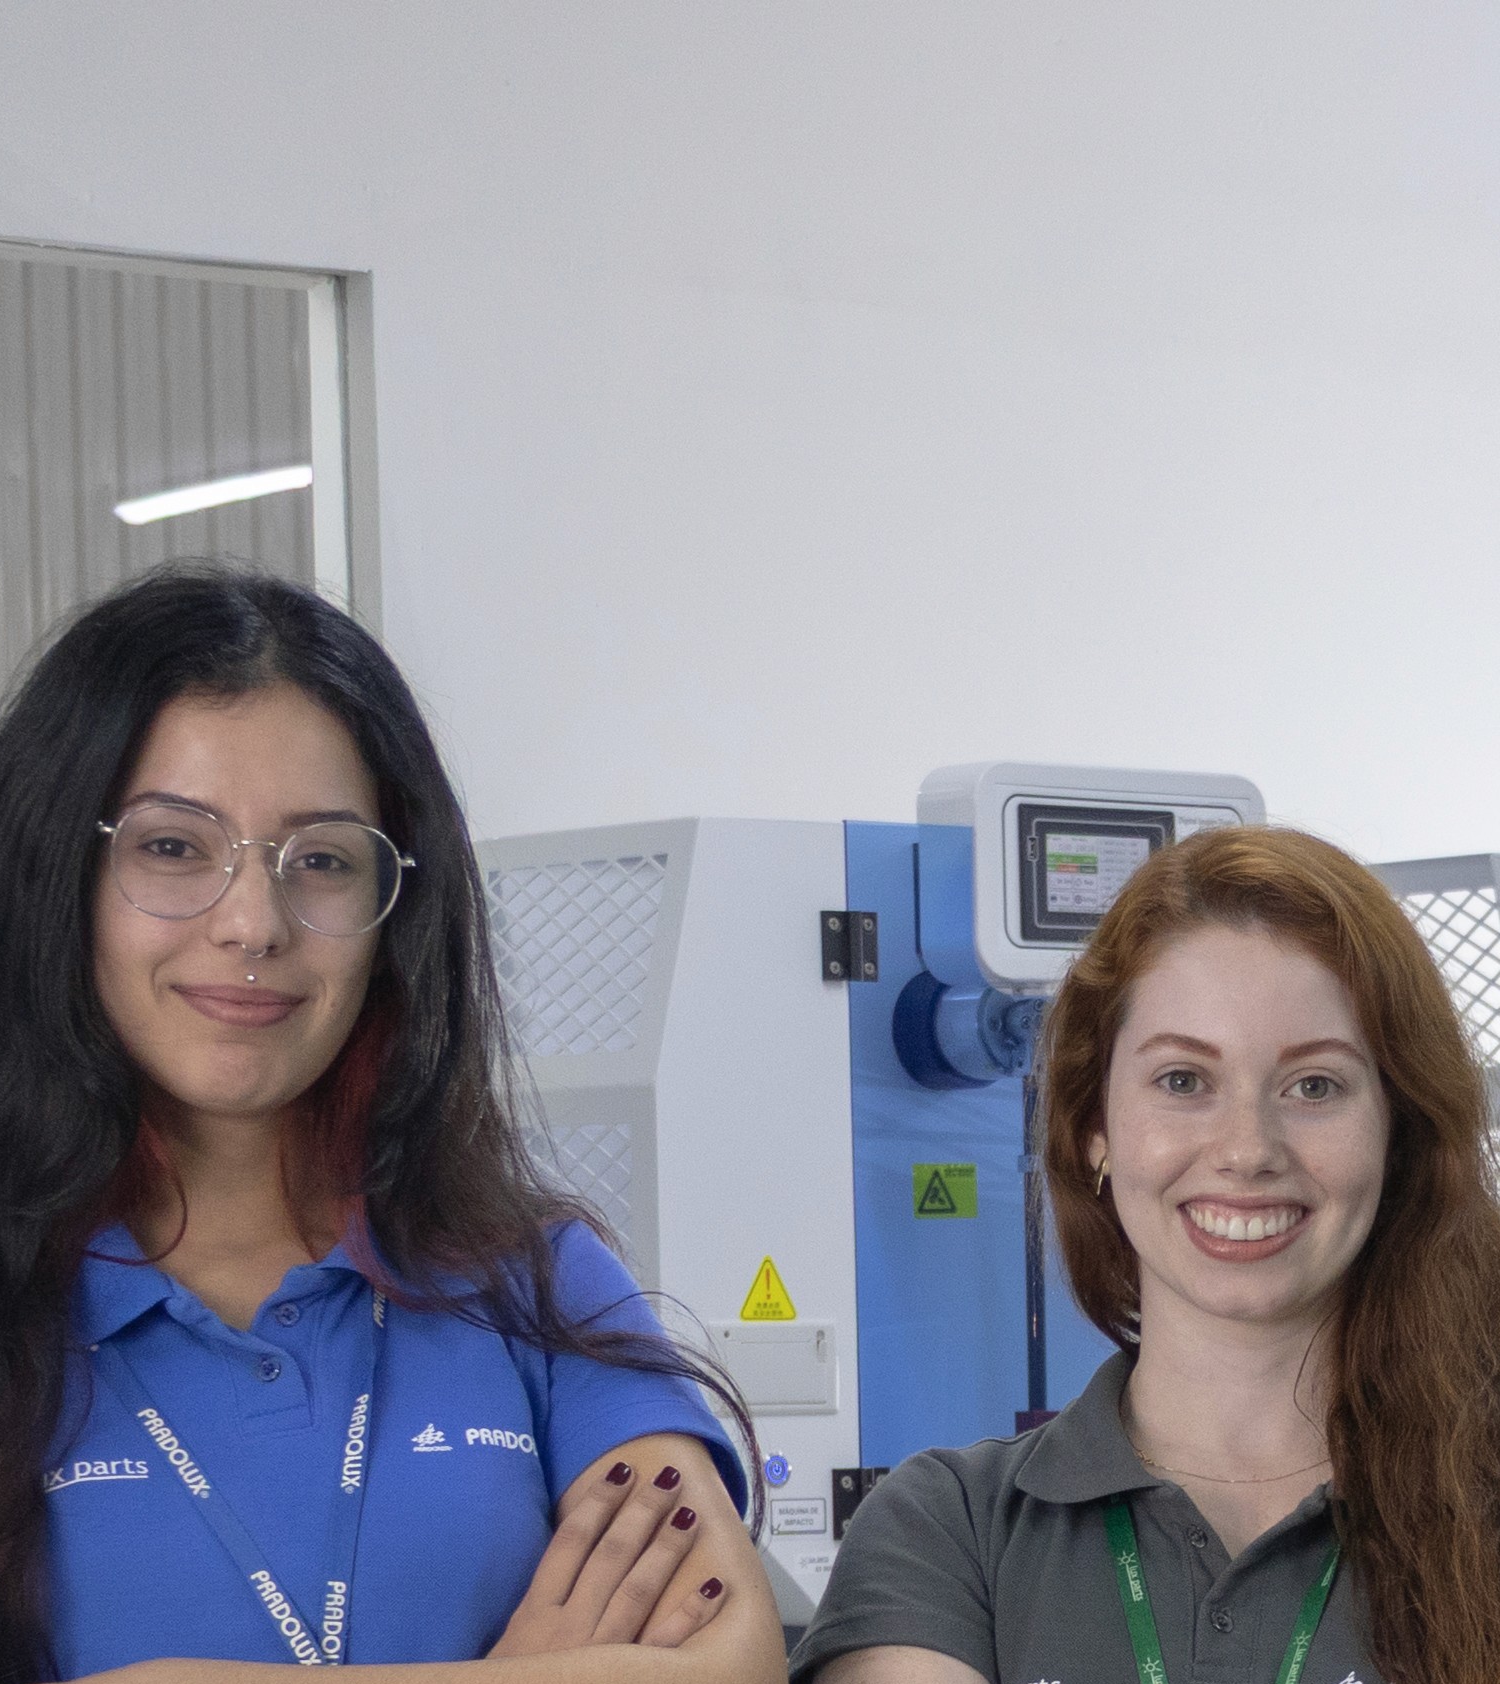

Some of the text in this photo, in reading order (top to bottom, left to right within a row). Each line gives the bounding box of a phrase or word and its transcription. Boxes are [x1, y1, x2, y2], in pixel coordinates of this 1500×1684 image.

[465, 1427, 538, 1456] PRADO
[73, 1457, 149, 1481] parts
[1132, 1581, 1145, 1601] parts
[250, 1570, 322, 1666] PRADOLUX
[322, 1580, 347, 1666] PRADOL
